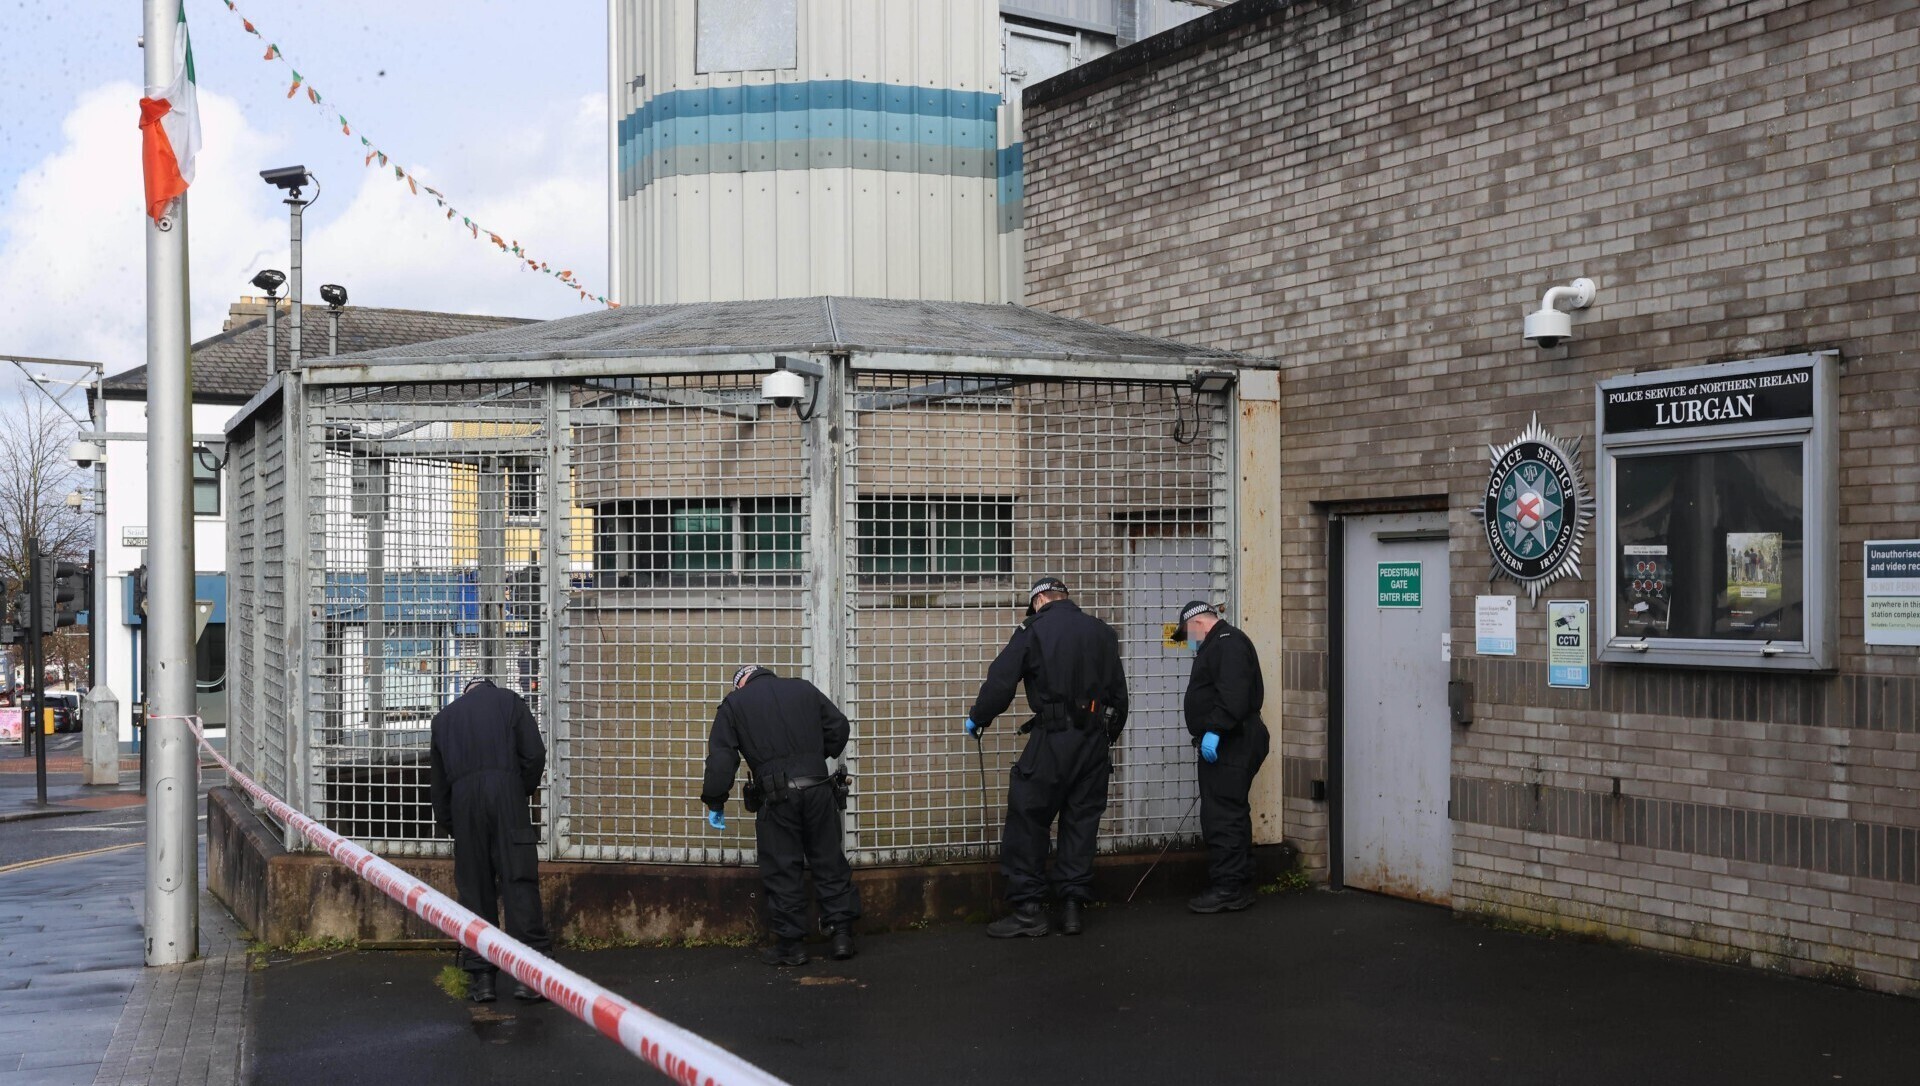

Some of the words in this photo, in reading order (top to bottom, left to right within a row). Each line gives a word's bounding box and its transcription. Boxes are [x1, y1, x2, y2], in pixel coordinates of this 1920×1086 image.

[1609, 390, 1643, 404] POLICE
[1644, 386, 1686, 400] SERVICE
[1688, 384, 1698, 396] of
[1700, 378, 1757, 394] NORTHERN
[1758, 372, 1809, 388] IRELAND
[1656, 394, 1754, 426] LURGAN
[1489, 448, 1523, 500] POLICE
[1536, 446, 1574, 500] SERVICE
[1489, 520, 1523, 572] NORTHERN
[1540, 524, 1571, 570] IRELAND
[1870, 562, 1884, 571] and
[1886, 562, 1906, 570] video
[1380, 568, 1420, 577] PEDESTRIAN
[1390, 580, 1408, 589] GATE
[1878, 582, 1894, 592] NOT
[1380, 593, 1400, 602] ENTER
[1402, 593, 1419, 602] HERE
[1871, 601, 1901, 609] anywhere
[1894, 610, 1920, 619] complex
[1558, 636, 1579, 645] CCTV
